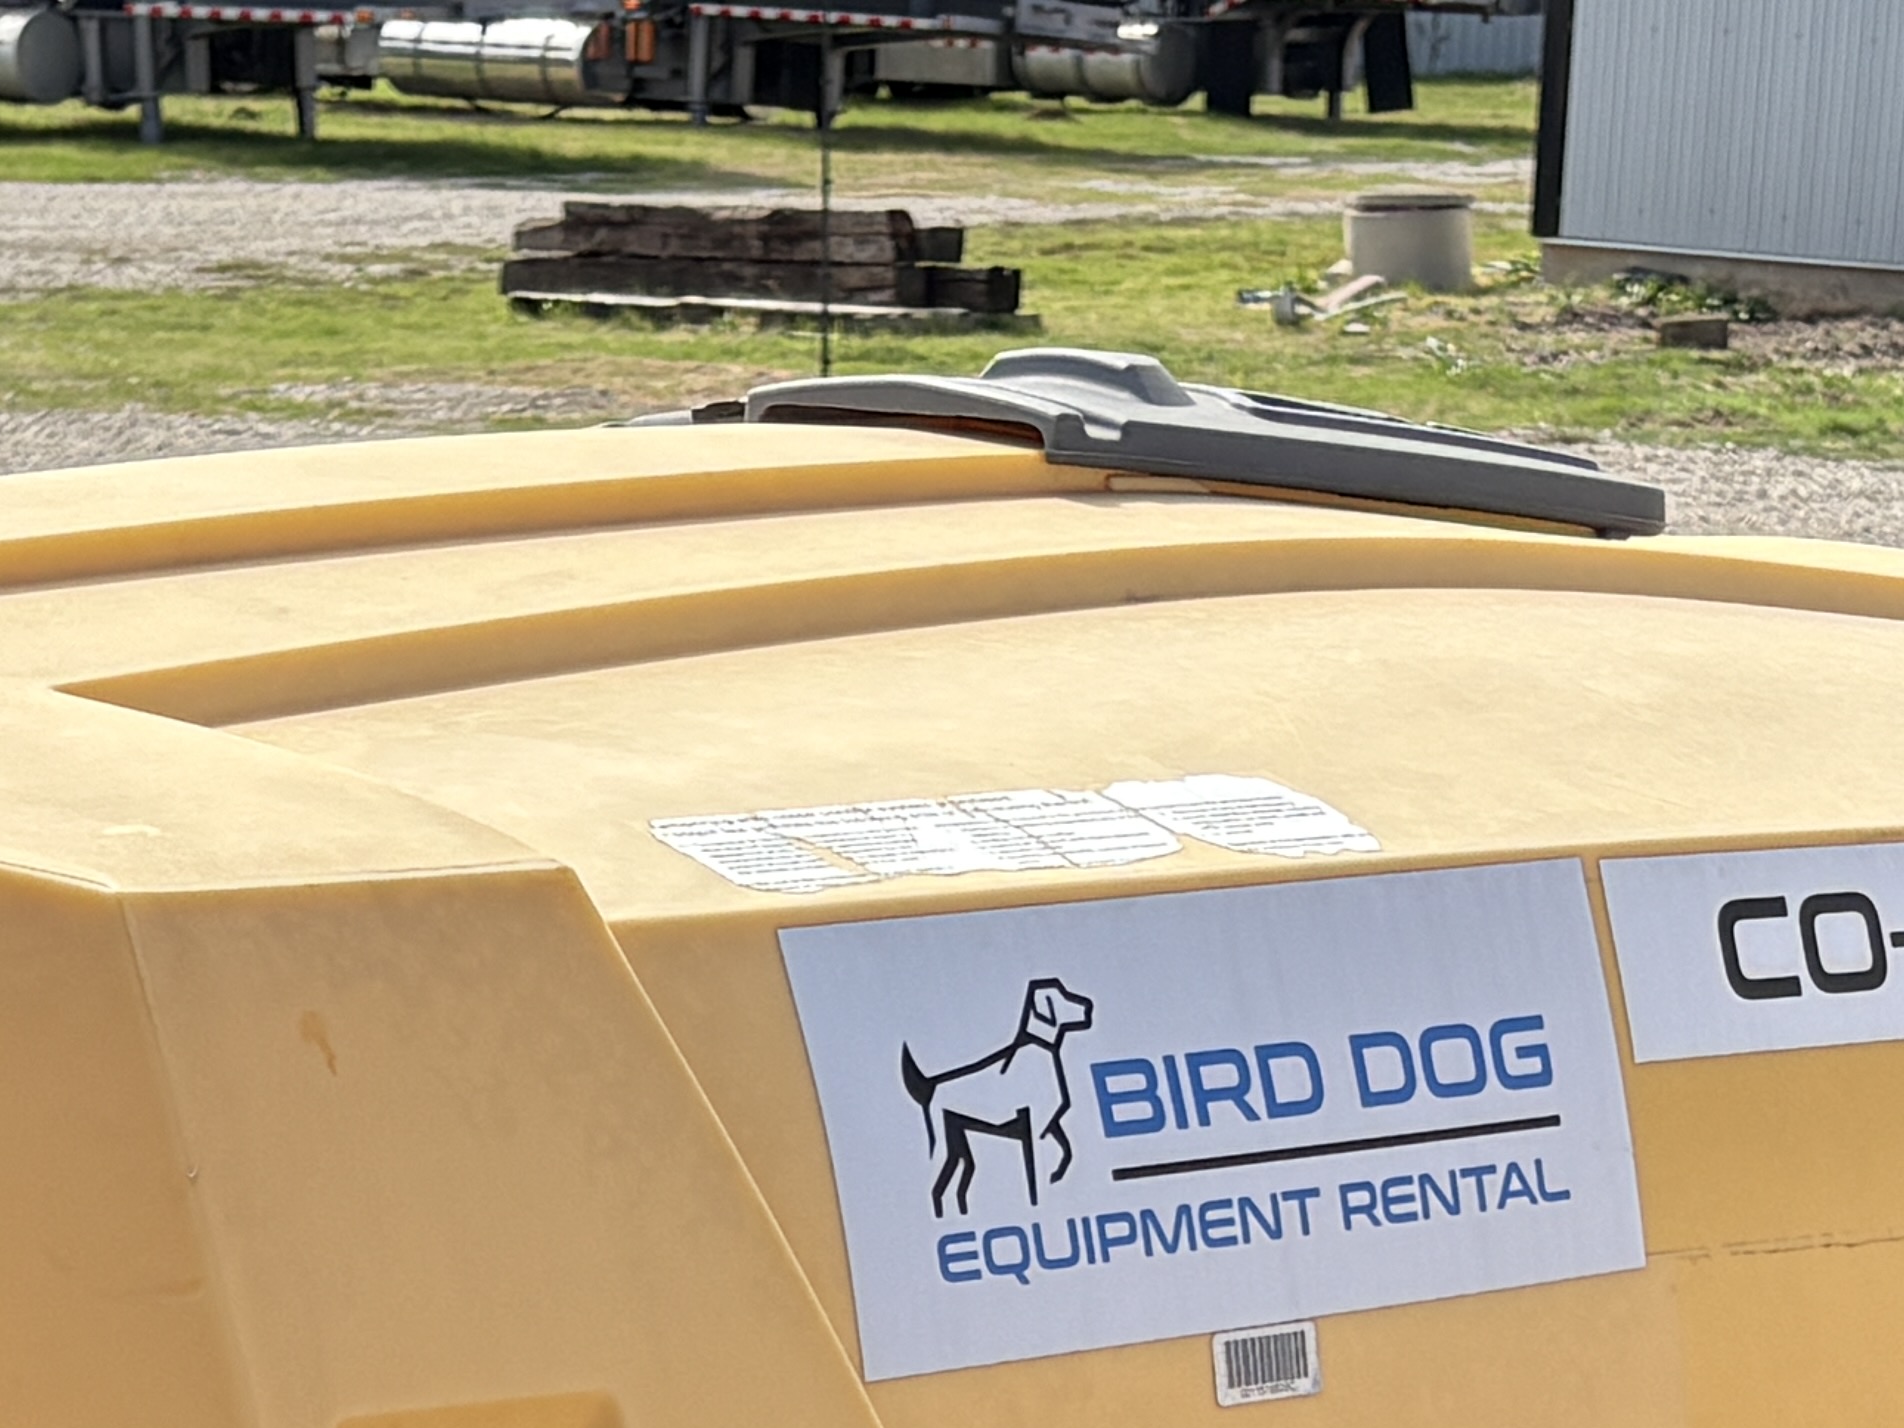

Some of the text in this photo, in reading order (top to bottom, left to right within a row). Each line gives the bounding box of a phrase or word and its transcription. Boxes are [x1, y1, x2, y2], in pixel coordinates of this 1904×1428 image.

[1089, 1014, 1555, 1139] BIRD DOG
[937, 1158, 1571, 1285] EQUIPMENT RENTAL
